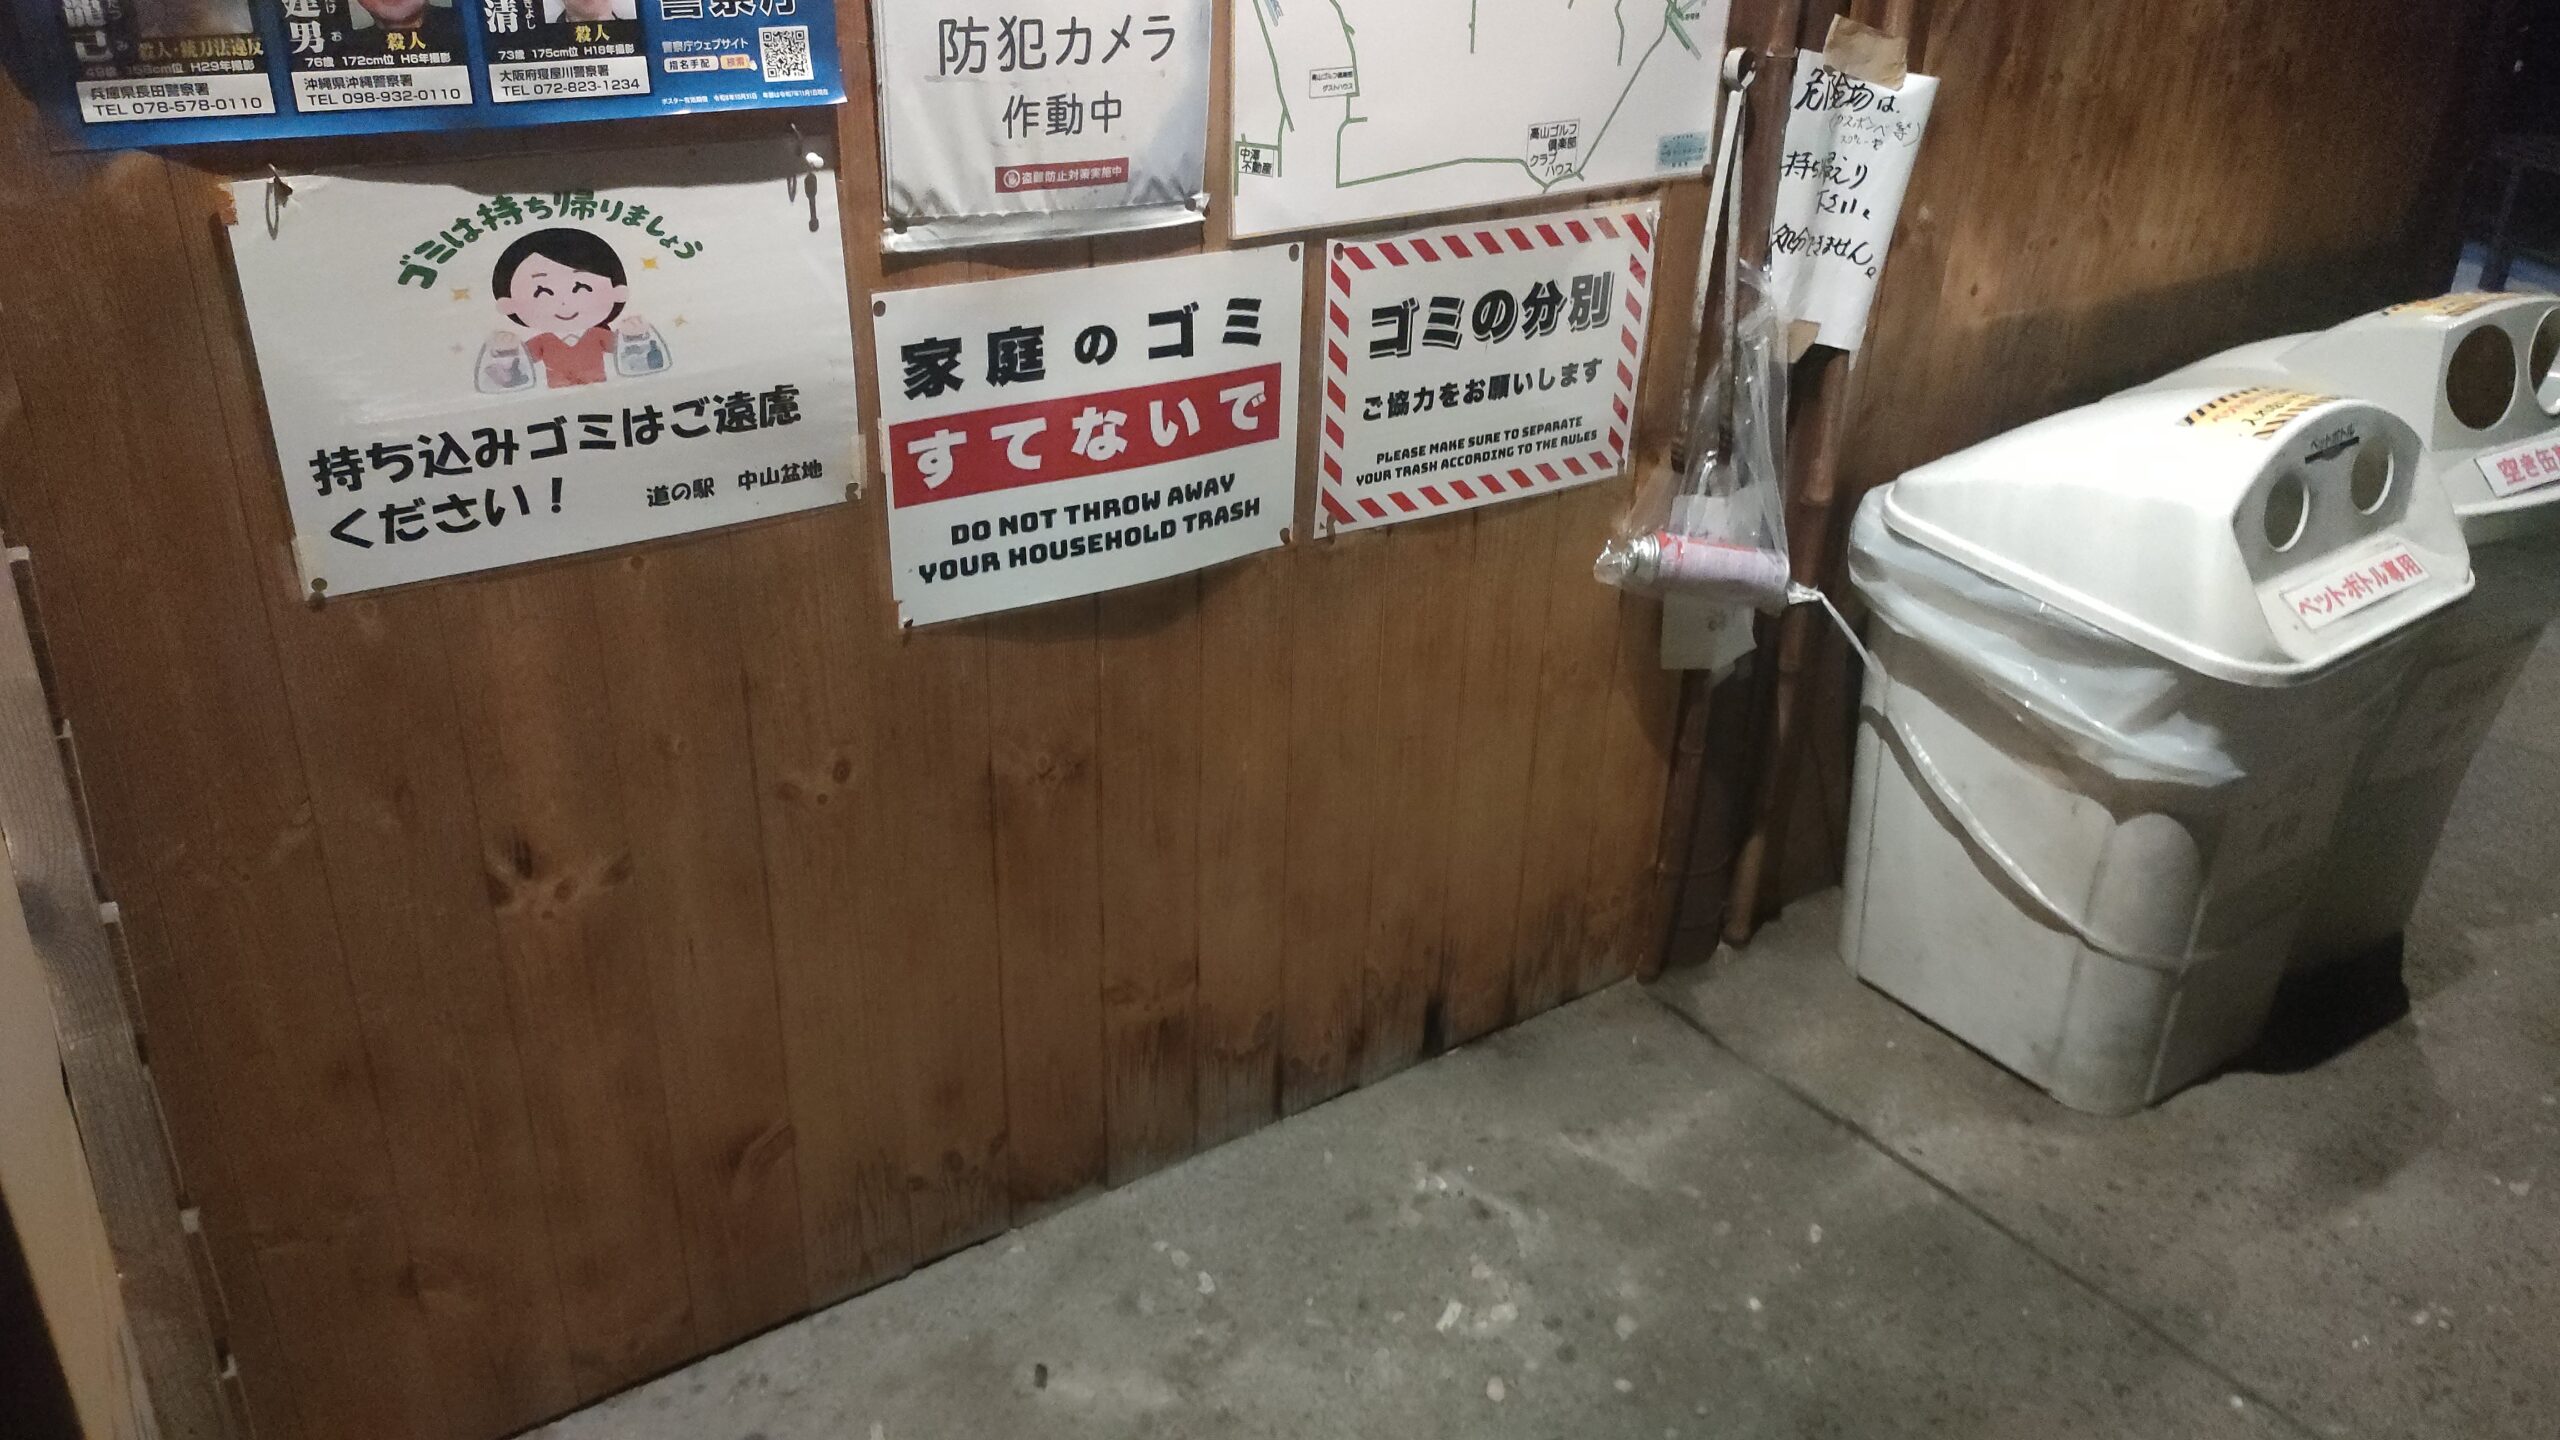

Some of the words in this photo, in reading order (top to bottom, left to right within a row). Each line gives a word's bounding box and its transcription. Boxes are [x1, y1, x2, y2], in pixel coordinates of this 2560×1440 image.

[387, 32, 426, 51] 殺人
[575, 24, 610, 43] 殺人
[662, 38, 748, 53] 警察庁ウェブサイト
[938, 14, 1176, 76] 防犯カメラ
[304, 74, 413, 91] 沖縄県沖縄警察署
[342, 54, 394, 66] 172cm位
[500, 64, 609, 82] 大阪府寝屋川警察署
[669, 58, 710, 70] 指名手配
[91, 82, 209, 101] 兵庫県長田警察署
[93, 103, 128, 116] TEL
[132, 97, 262, 115] 078-578-0110
[307, 94, 337, 106] TEL
[342, 88, 460, 104] 098-932-0110
[502, 86, 530, 96] TEL
[534, 78, 640, 95] 072-823-1234
[1002, 90, 1122, 139] 作動中
[1530, 151, 1557, 167] クラブ
[1545, 163, 1573, 177] ハウス
[397, 190, 704, 290] ゴミは持ち帰りましょう
[1368, 270, 1615, 359] ゴミの分別
[900, 298, 1262, 399] 家庭のゴミ
[1362, 358, 1602, 421] ご協力をお願いします
[309, 384, 801, 496] 持ち込みゴミはご遠慮
[908, 381, 1266, 489] すてないで
[1356, 470, 1392, 487] YOUR
[1395, 460, 1437, 478] TRASH
[1440, 447, 1514, 470] ACCORDING
[1517, 443, 1532, 456] TO
[1536, 437, 1557, 452] THE
[1560, 429, 1598, 447] RULES
[1376, 448, 1426, 465] PLEASE
[1429, 439, 1465, 454] MAKE
[1467, 432, 1500, 448] SURE
[1503, 427, 1519, 441] TO
[1522, 415, 1583, 438] SEPARATE
[646, 477, 715, 507] 道の駅
[738, 459, 823, 491] 中山盆地
[330, 477, 564, 549] ください！
[951, 520, 991, 546] DO
[999, 508, 1057, 536] NOT
[1064, 489, 1161, 525] THROW
[1168, 473, 1235, 507] AWAY
[919, 552, 1000, 584] YOUR
[1009, 518, 1177, 568] HOUSEHOLD
[1183, 497, 1260, 534] TRASH
[2298, 554, 2423, 615] ペットボトル専用
